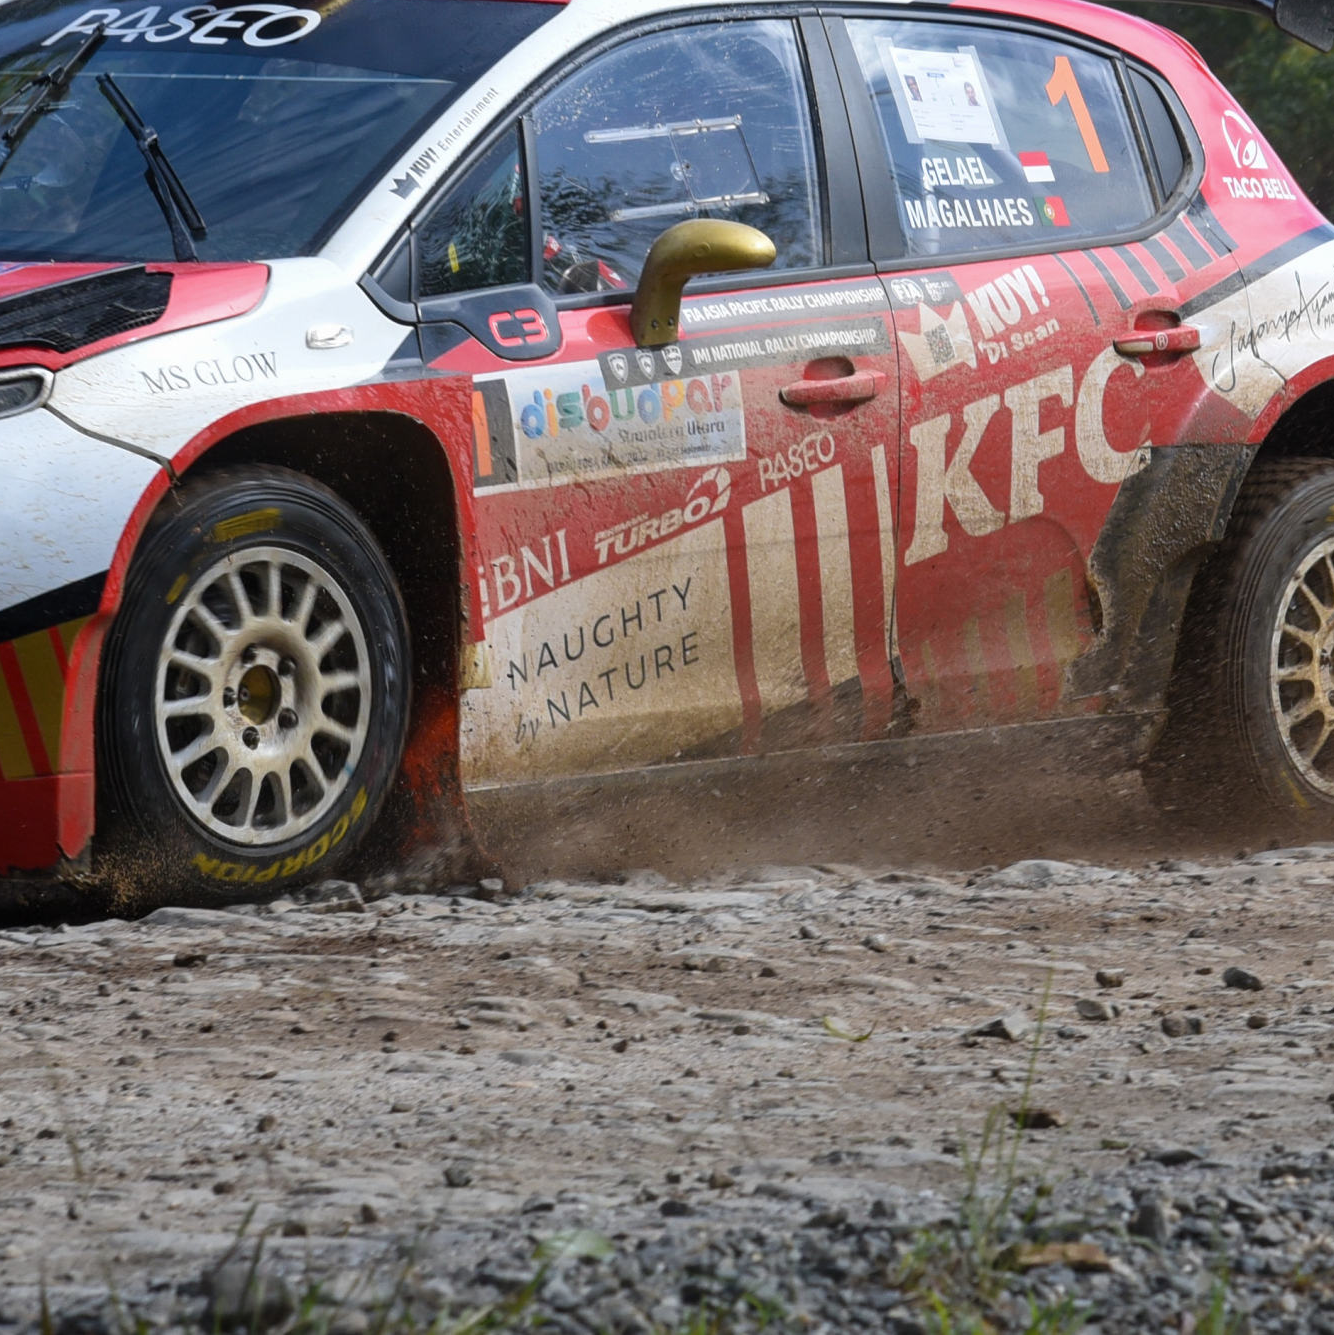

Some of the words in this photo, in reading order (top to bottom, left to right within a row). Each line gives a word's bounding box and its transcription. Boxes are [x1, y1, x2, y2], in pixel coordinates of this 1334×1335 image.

[41, 3, 322, 48] PASEO
[437, 87, 499, 152] Entertainment
[1045, 55, 1110, 173] 1
[921, 157, 995, 187] GELAEL
[1222, 176, 1264, 199] TACO
[1260, 177, 1297, 201] BELL
[904, 197, 1034, 229] MAGALHAES
[488, 307, 548, 347] C3
[682, 307, 702, 324] FIA
[702, 303, 731, 321] ASIA
[730, 298, 774, 318] PACIFIC
[770, 294, 805, 314] RALLY
[804, 286, 885, 310] CHAMPIONSHIP
[964, 264, 1051, 340] KUY!
[691, 346, 712, 365] IMI
[711, 338, 766, 363] NATIONAL
[765, 335, 798, 354] RALLY
[798, 327, 878, 351] CHAMPIONSHIP
[1010, 318, 1060, 352] Scan
[139, 364, 192, 395] MS
[193, 351, 279, 387] GLOW
[520, 372, 733, 440] disbudpar
[686, 419, 726, 436] Utara
[757, 429, 836, 494] PASEO
[904, 345, 1153, 567] KFC
[594, 495, 711, 565] TURBO
[490, 527, 572, 611] BNI
[507, 576, 692, 691] NAUGHTY
[546, 631, 700, 729] NATURE
